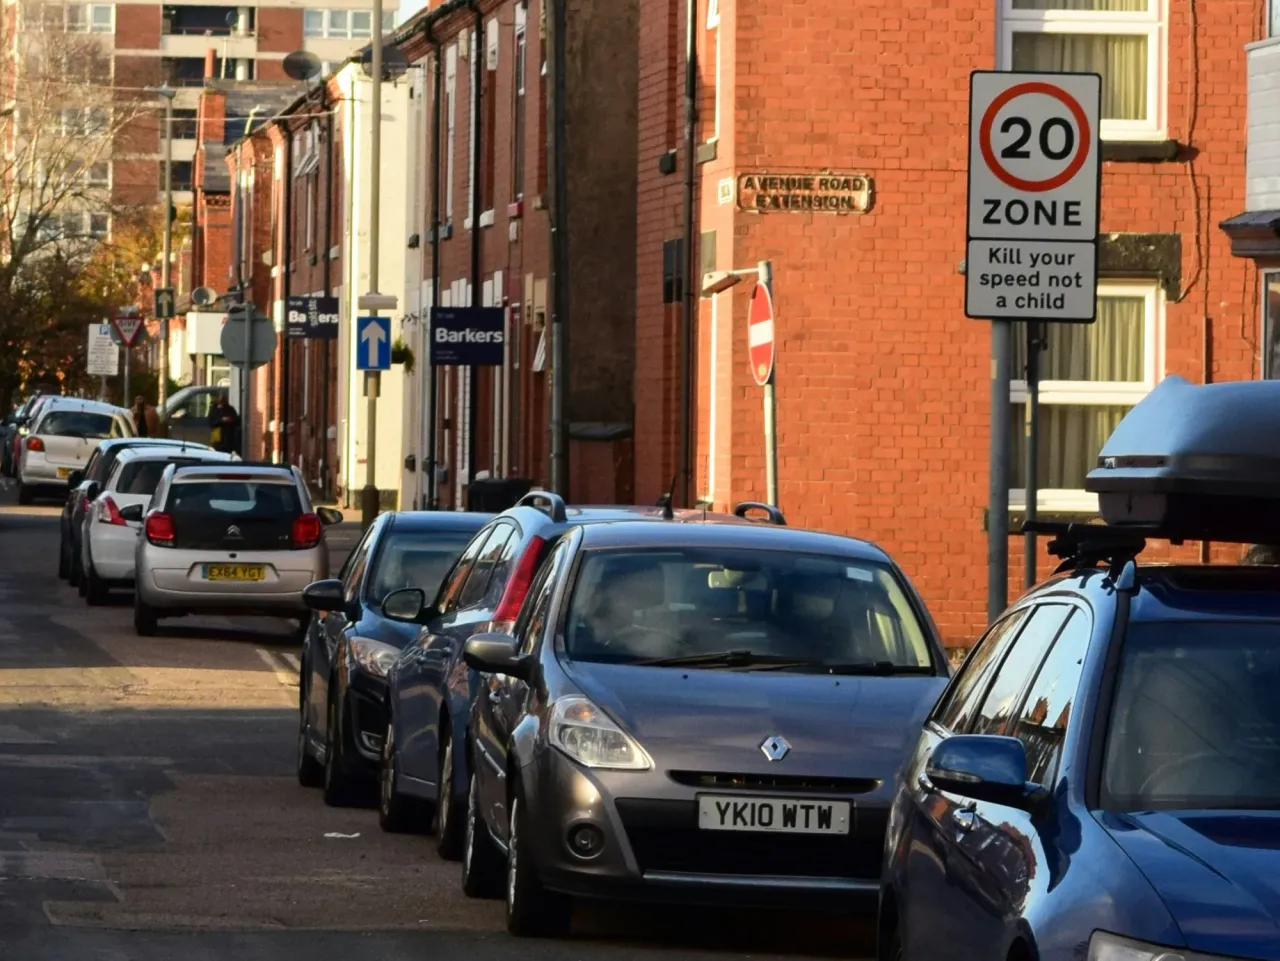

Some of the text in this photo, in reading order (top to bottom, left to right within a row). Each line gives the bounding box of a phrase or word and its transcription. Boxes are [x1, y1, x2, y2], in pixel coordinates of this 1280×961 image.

[1000, 116, 1075, 160] 20
[744, 176, 863, 192] AVENUE ROAD
[756, 194, 853, 210] EXTENSION
[982, 198, 1082, 227] ZONE
[988, 247, 1075, 268] Kill your
[979, 271, 1083, 289] speed not
[996, 293, 1065, 310] a child
[288, 310, 340, 324] Baers
[435, 327, 504, 343] Barkers
[715, 801, 833, 829] YK10 WTW
